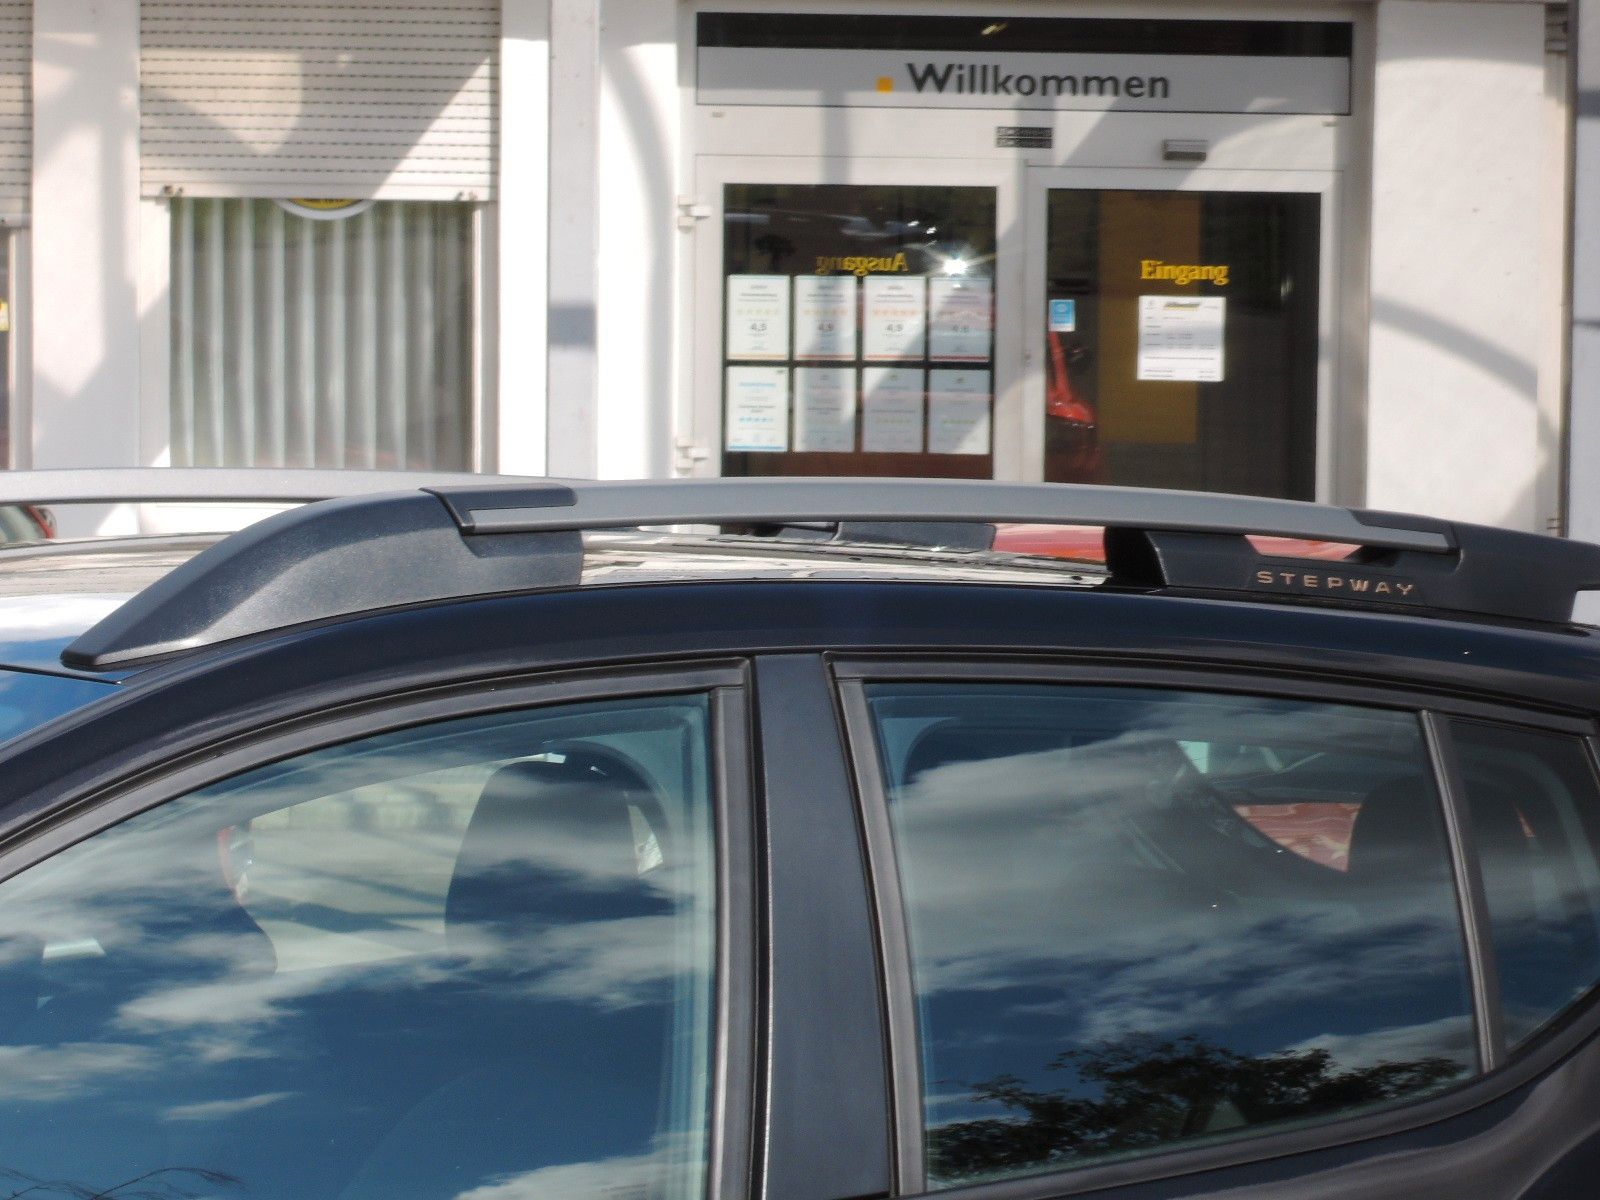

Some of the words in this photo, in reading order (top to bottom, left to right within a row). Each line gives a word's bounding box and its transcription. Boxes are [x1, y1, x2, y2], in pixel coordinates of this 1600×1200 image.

[907, 62, 1169, 98] Willkommen
[1141, 259, 1229, 286] Eingang
[1257, 571, 1413, 595] STEPWAY
